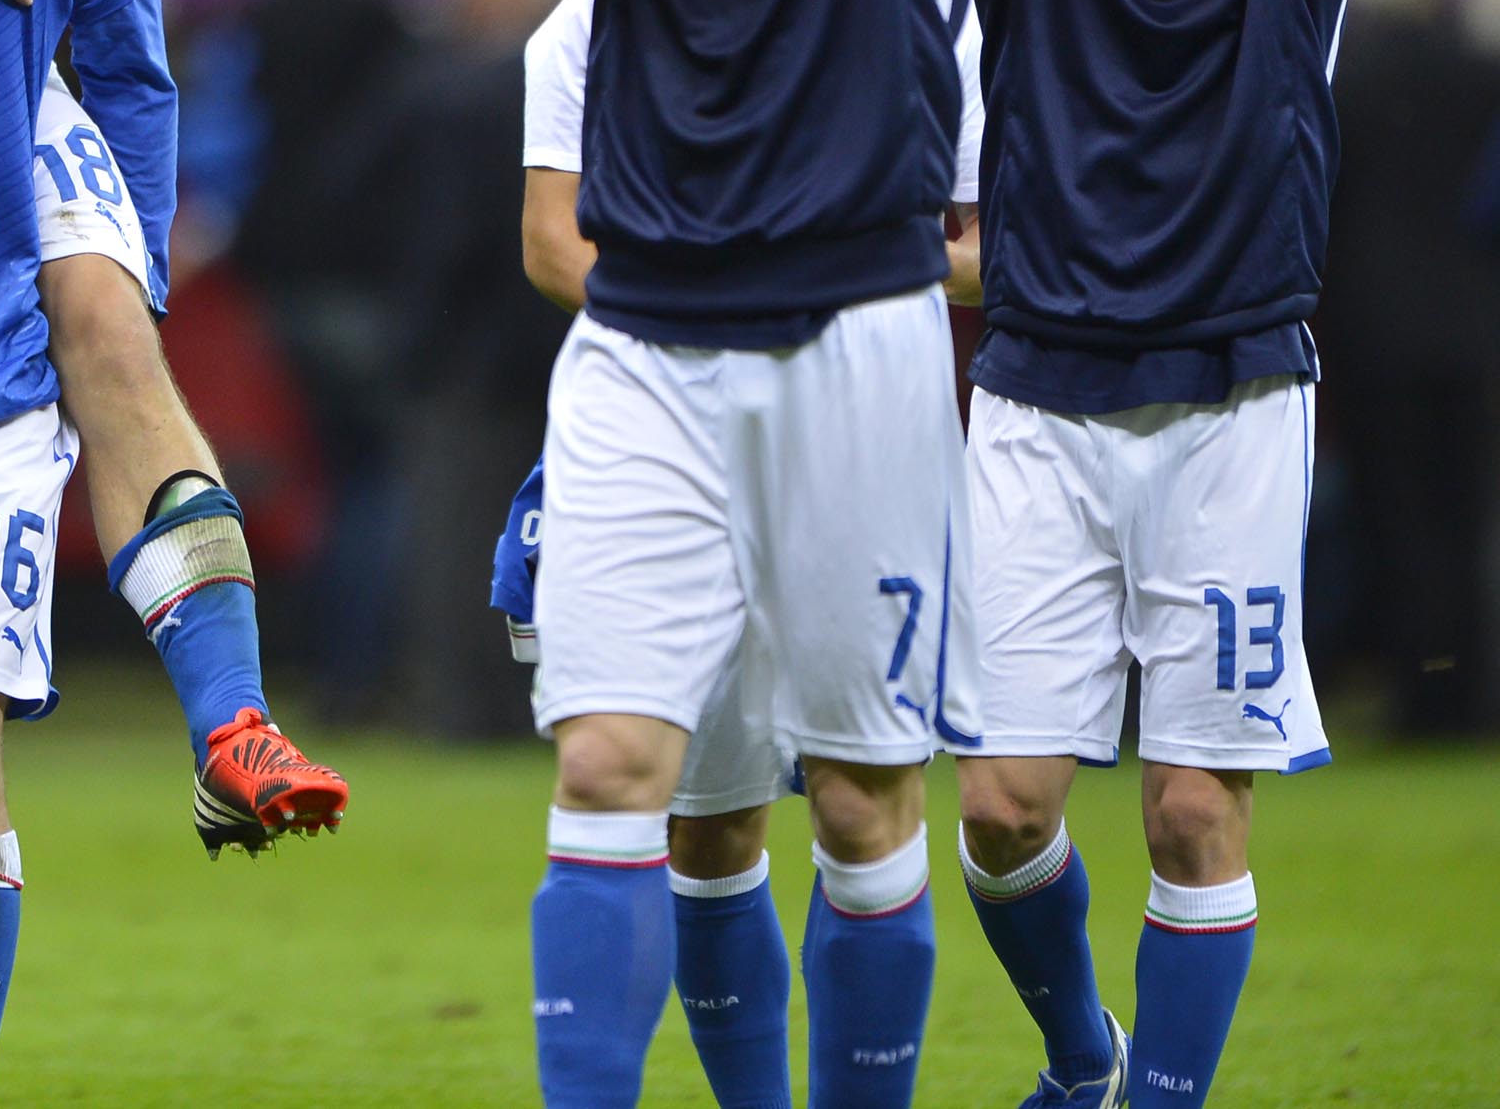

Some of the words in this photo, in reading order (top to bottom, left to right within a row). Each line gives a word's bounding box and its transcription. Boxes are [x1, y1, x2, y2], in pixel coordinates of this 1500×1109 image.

[35, 125, 123, 207] 18
[879, 576, 923, 682] 7
[1204, 585, 1287, 690] 13
[684, 995, 740, 1010] ITALIA
[853, 1042, 916, 1066] ITALIA
[1147, 1069, 1194, 1094] ITALIA
